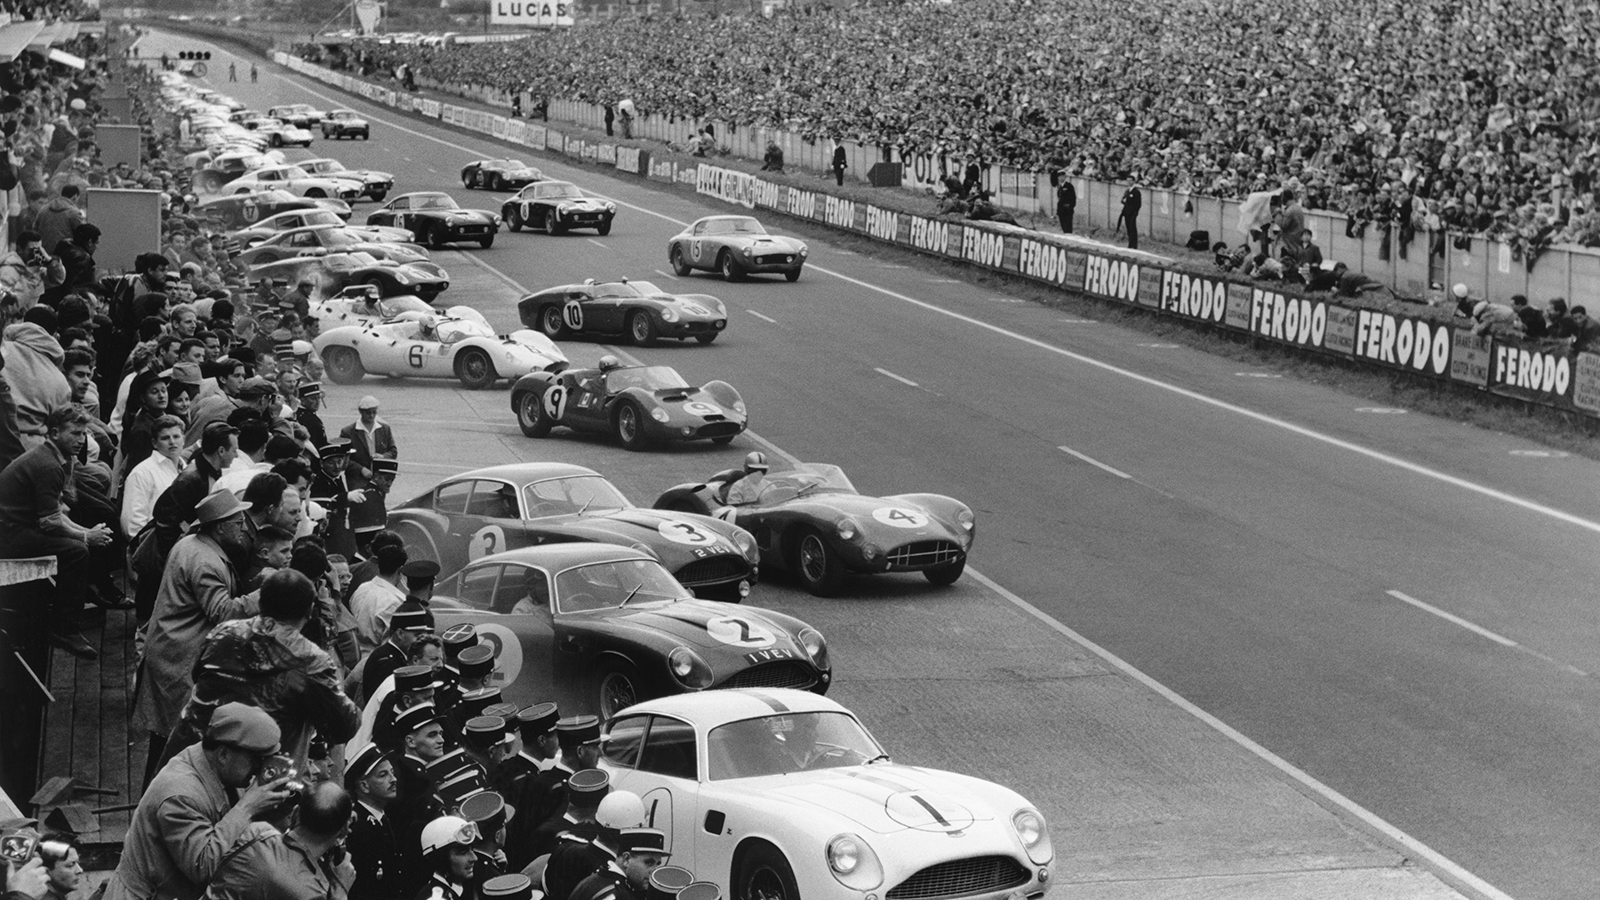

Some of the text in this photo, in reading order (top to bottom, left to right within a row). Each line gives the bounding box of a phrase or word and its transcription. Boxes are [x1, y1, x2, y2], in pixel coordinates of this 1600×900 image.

[498, 3, 567, 17] LUCAS
[787, 187, 815, 218] FERODO
[825, 195, 854, 228] FERODO
[866, 204, 898, 242] FERODO
[910, 215, 948, 254] FERODO
[692, 240, 700, 258] 15
[962, 226, 1004, 268] FERODO
[1020, 238, 1066, 284] FERODO
[1085, 254, 1138, 302] FERODO
[1161, 270, 1226, 322] FERODO
[567, 305, 580, 326] 10
[1252, 288, 1326, 346] FERODO
[409, 345, 424, 368] 6
[1356, 310, 1449, 374] FERODO
[1496, 346, 1570, 396] FERODO
[551, 387, 563, 418] 9
[690, 403, 716, 413] 9
[672, 523, 707, 541] 3
[889, 509, 917, 525] 4
[695, 545, 730, 557] 2 VEV
[718, 618, 767, 644] 2
[759, 649, 793, 660] VEV
[910, 795, 951, 827] 1
